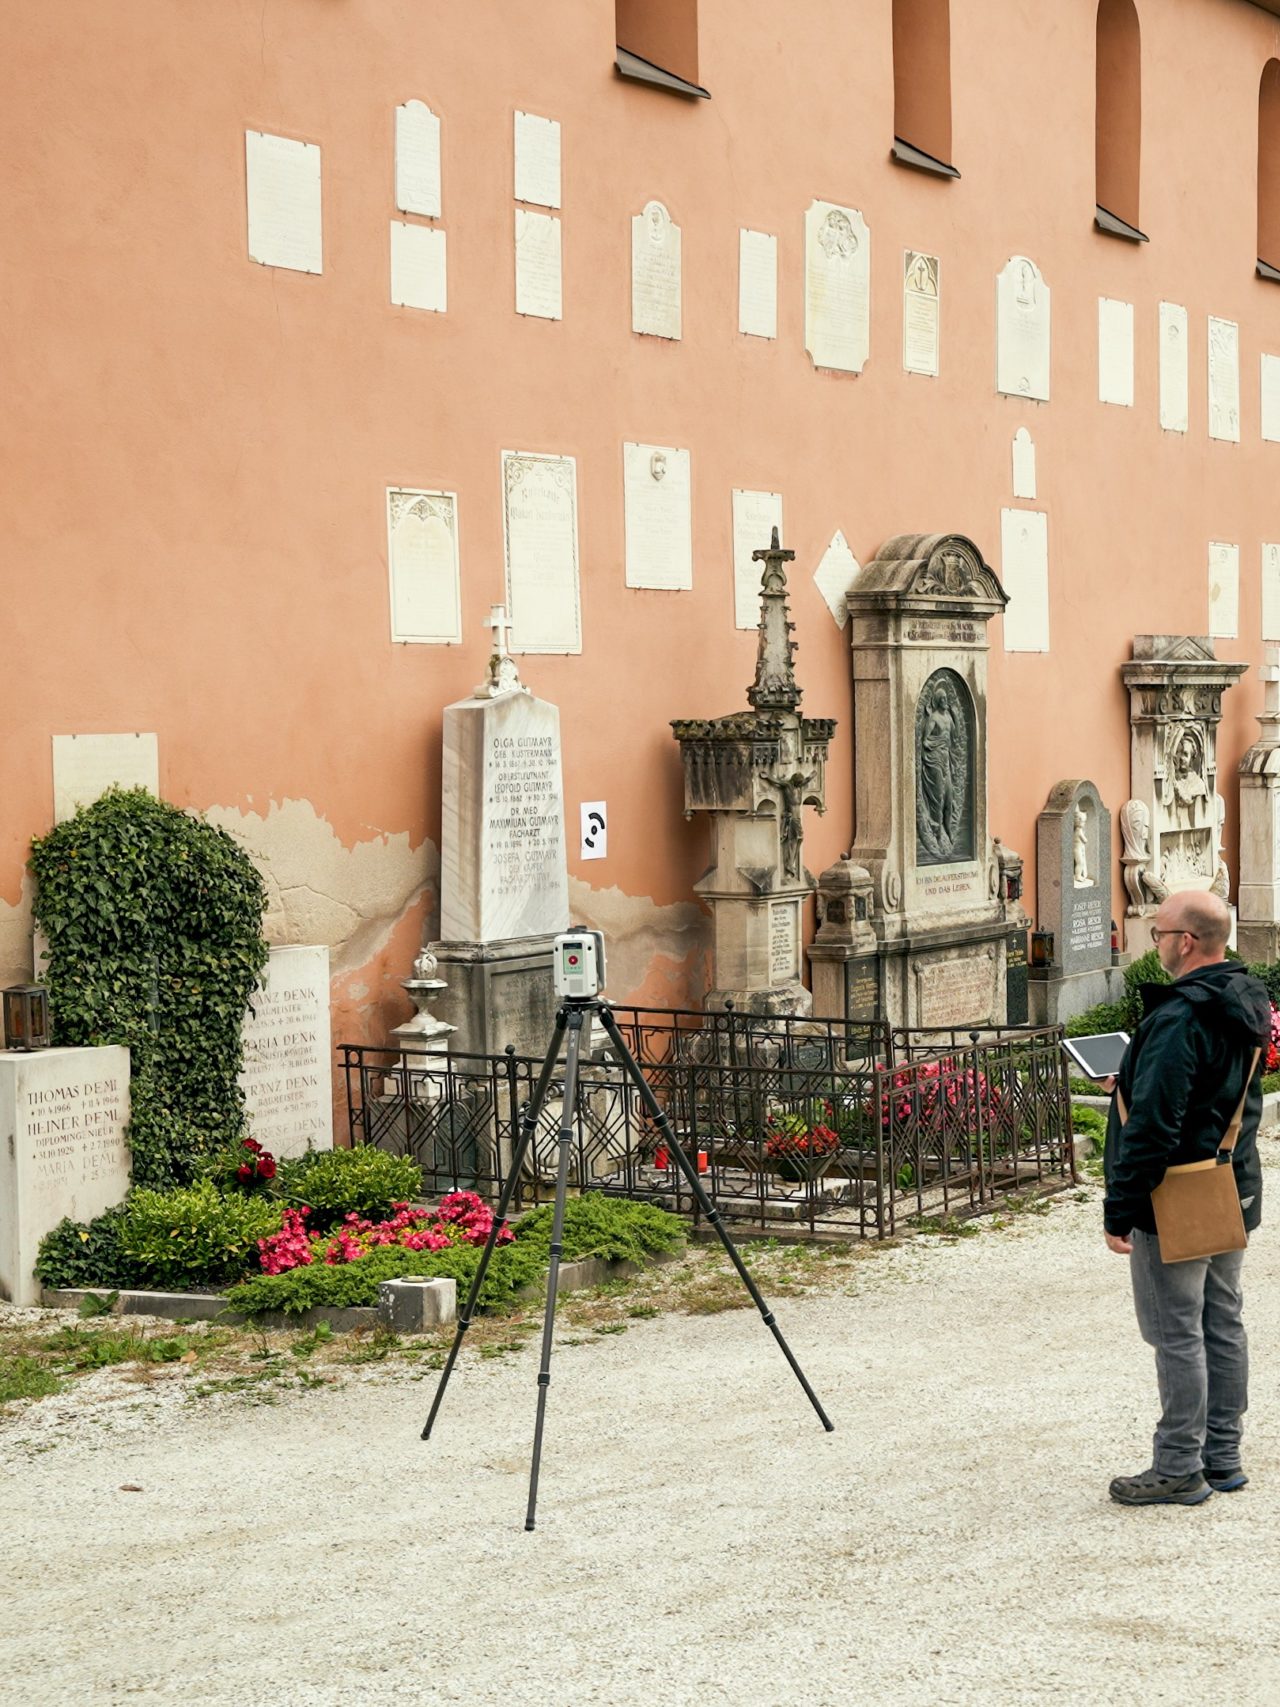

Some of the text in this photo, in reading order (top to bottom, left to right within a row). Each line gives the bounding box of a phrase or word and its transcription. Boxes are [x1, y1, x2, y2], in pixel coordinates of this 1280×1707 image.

[494, 736, 552, 749] OLGA GUTMAYR
[494, 780, 553, 794] LEOPOLD GUTMAYR
[489, 814, 559, 829] MAXIMILIAN GUTMAYR
[509, 828, 541, 839] FACHARZT
[525, 849, 557, 862] GUTMAYR
[924, 886, 937, 896] UND
[938, 885, 951, 894] DAS
[283, 987, 315, 1002] DENK
[283, 1031, 317, 1047] DENK
[27, 1079, 119, 1105] THOMAS DEML
[243, 1075, 318, 1097] FRANZ DENK
[27, 1108, 119, 1136] HEINER DEML
[294, 1117, 326, 1132] DENK
[36, 1126, 114, 1148] DIPLOMINGENIEUR
[38, 1151, 118, 1177] MARIA DEML
